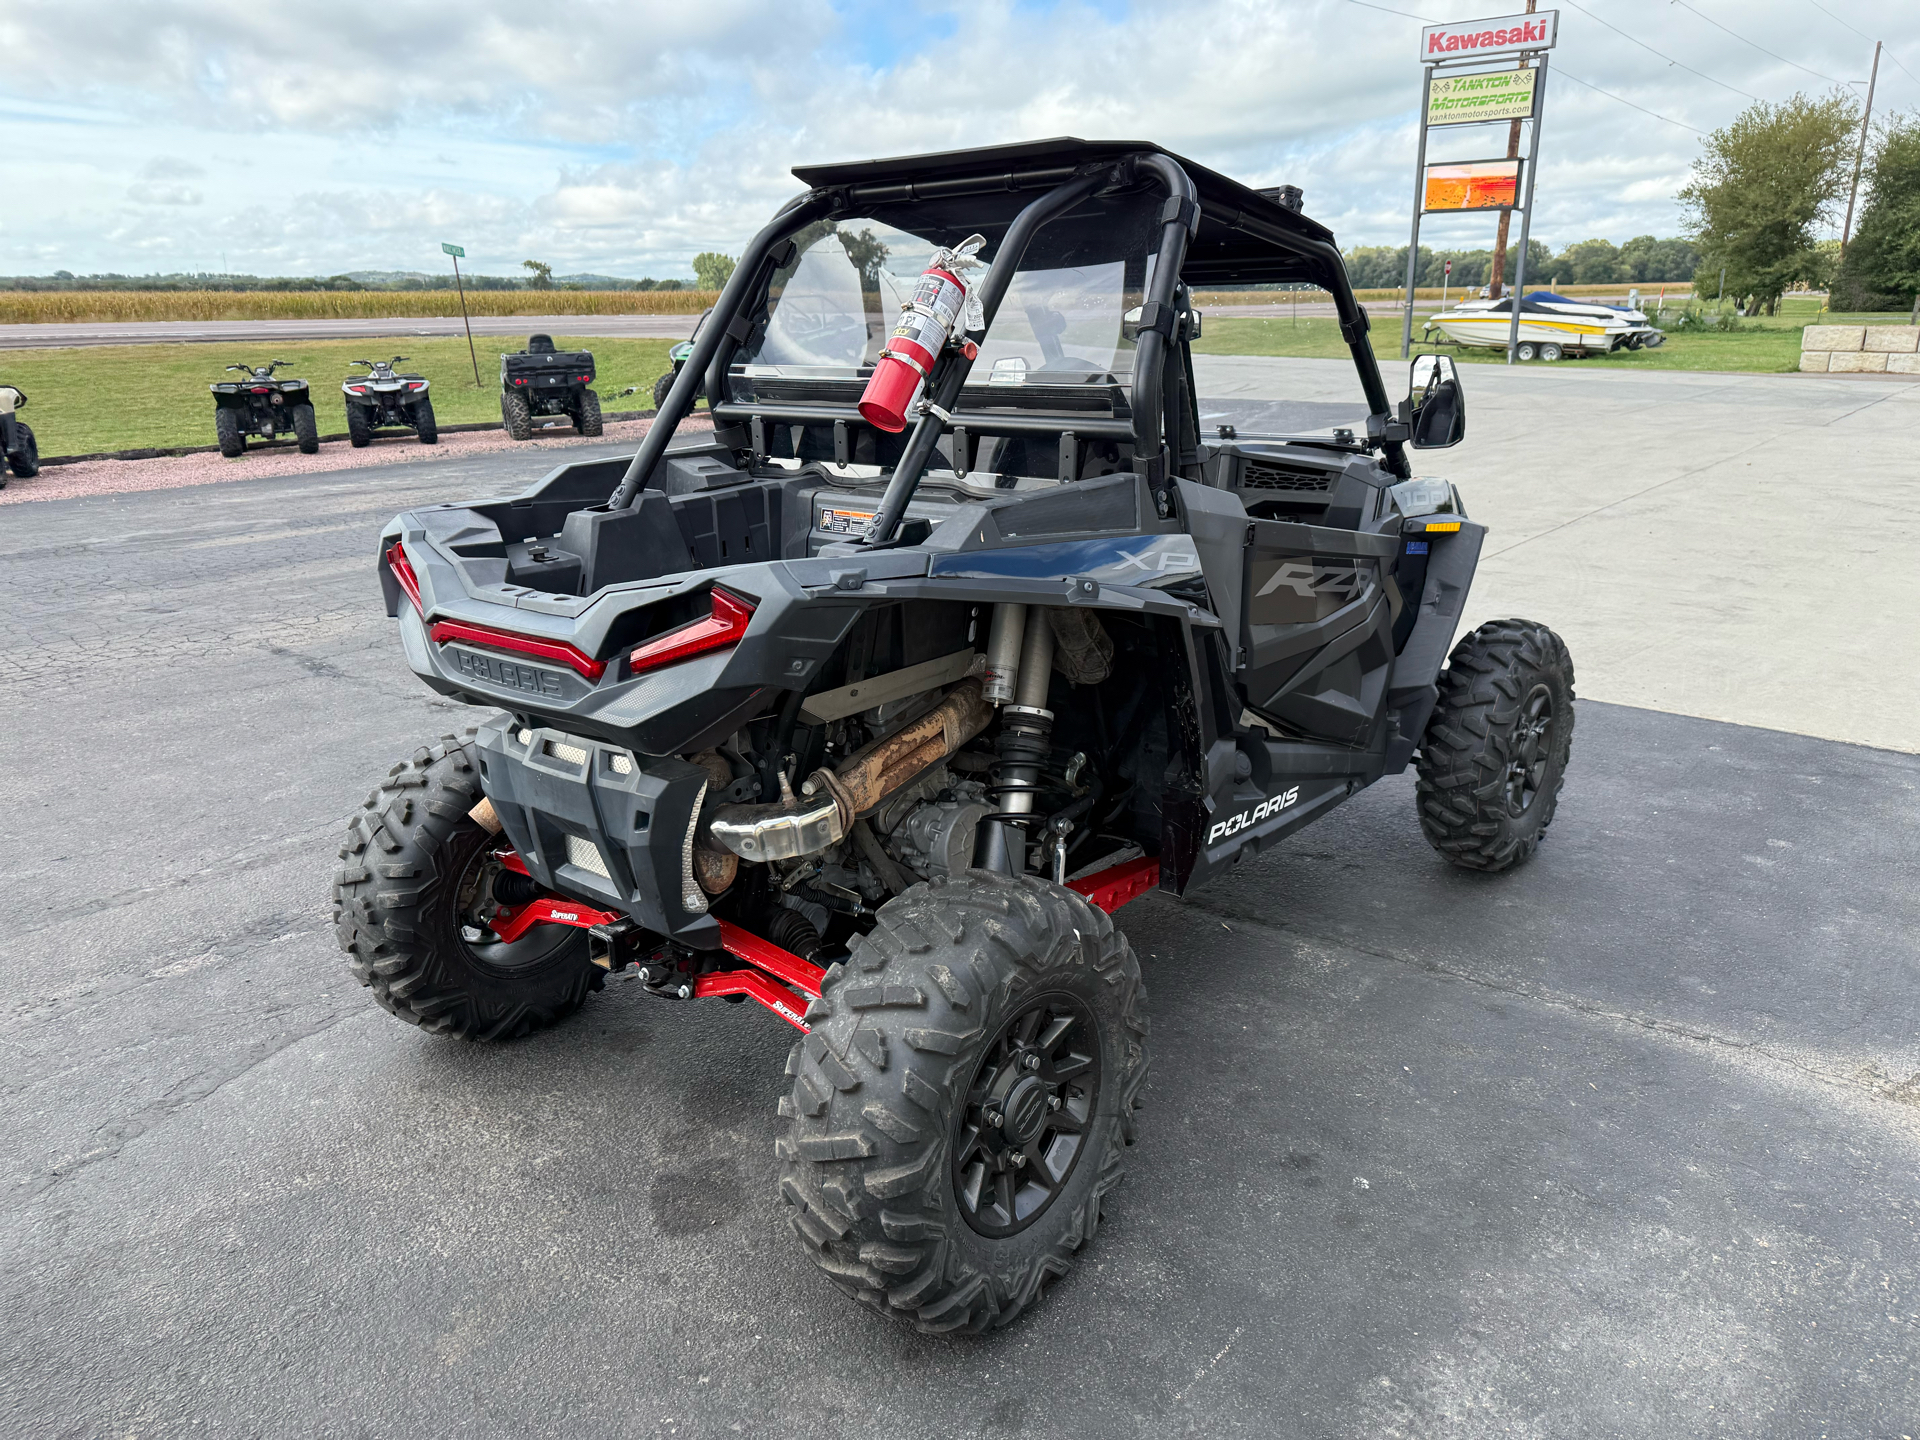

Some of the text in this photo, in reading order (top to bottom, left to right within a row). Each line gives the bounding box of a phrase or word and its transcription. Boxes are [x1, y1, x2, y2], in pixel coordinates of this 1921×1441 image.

[1428, 19, 1546, 53] Kawasaki
[1452, 75, 1512, 92] YANKTON
[1430, 91, 1531, 111] MOTORSPORTS
[1429, 105, 1530, 123] yanktonmotorsports.com
[1112, 550, 1196, 571] XP
[456, 650, 564, 697] POLARIS
[1207, 785, 1299, 845] POLARIS
